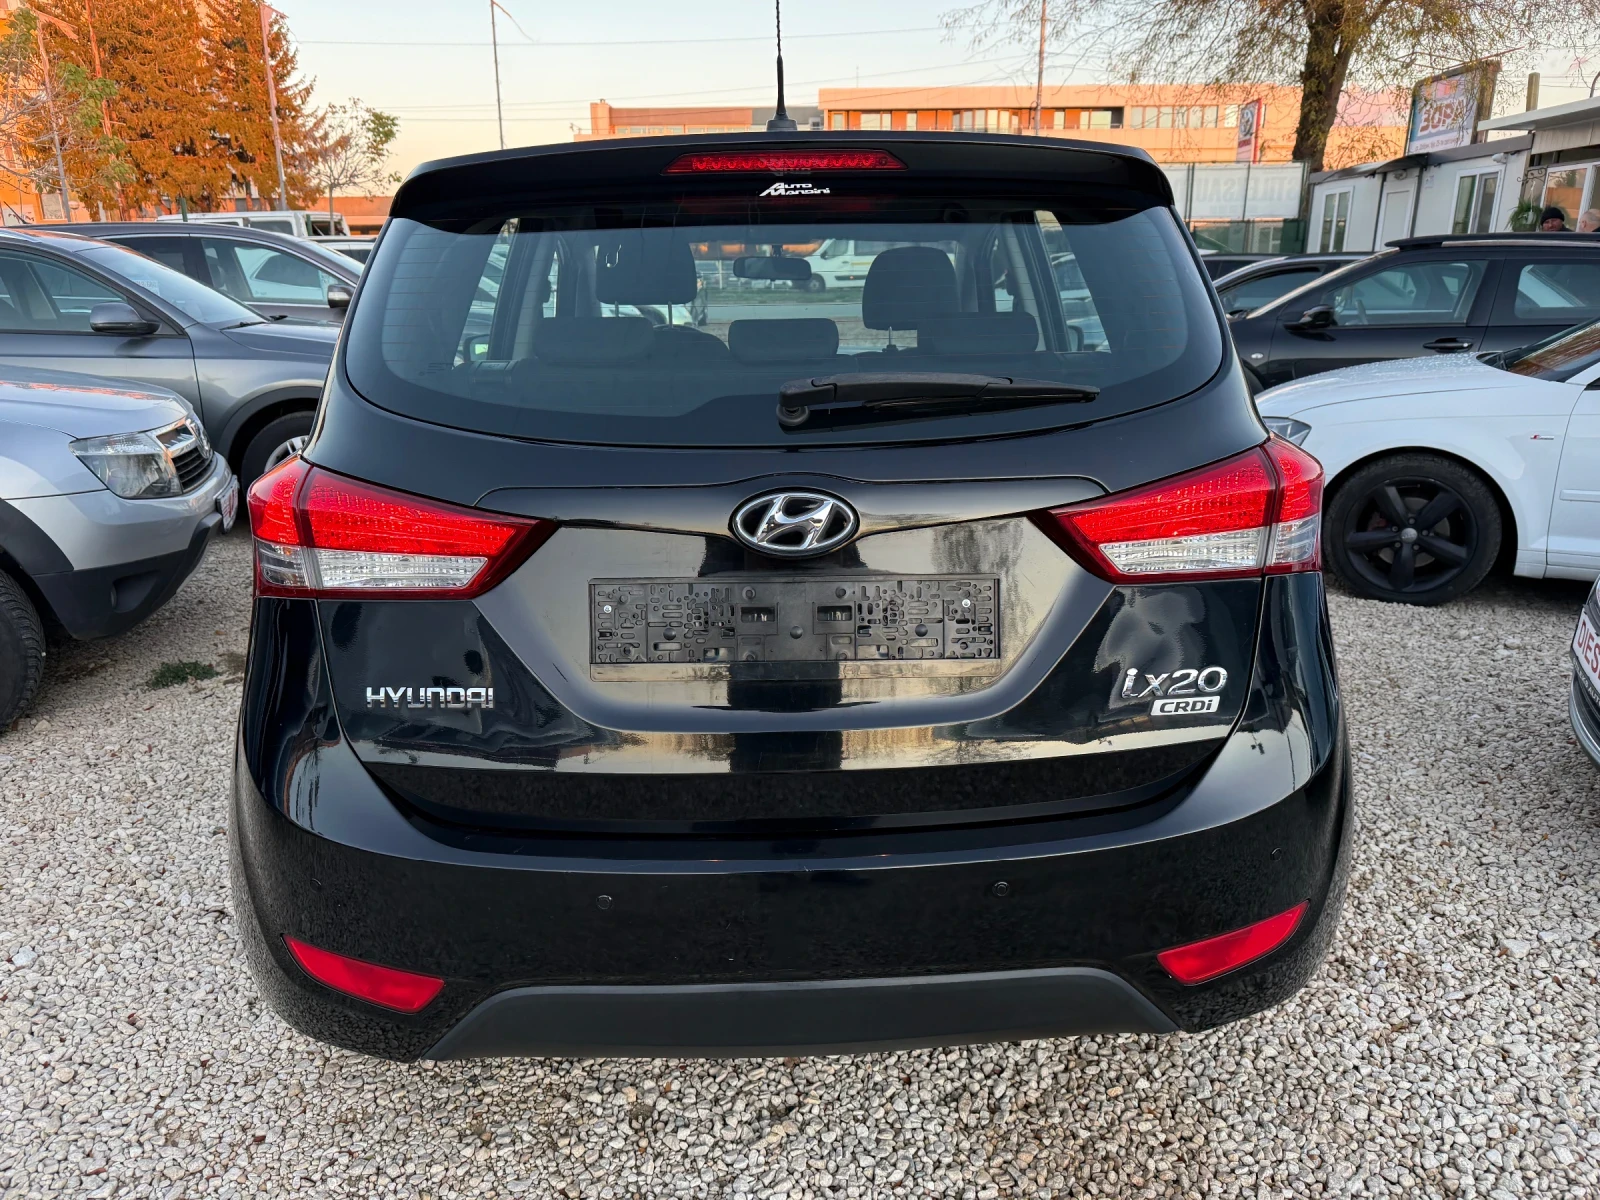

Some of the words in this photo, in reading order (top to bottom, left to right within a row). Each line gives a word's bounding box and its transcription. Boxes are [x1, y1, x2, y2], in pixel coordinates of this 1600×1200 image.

[1577, 619, 1600, 681] DIES
[366, 686, 494, 709] HYUNDAI
[1159, 699, 1214, 714] CRDi
